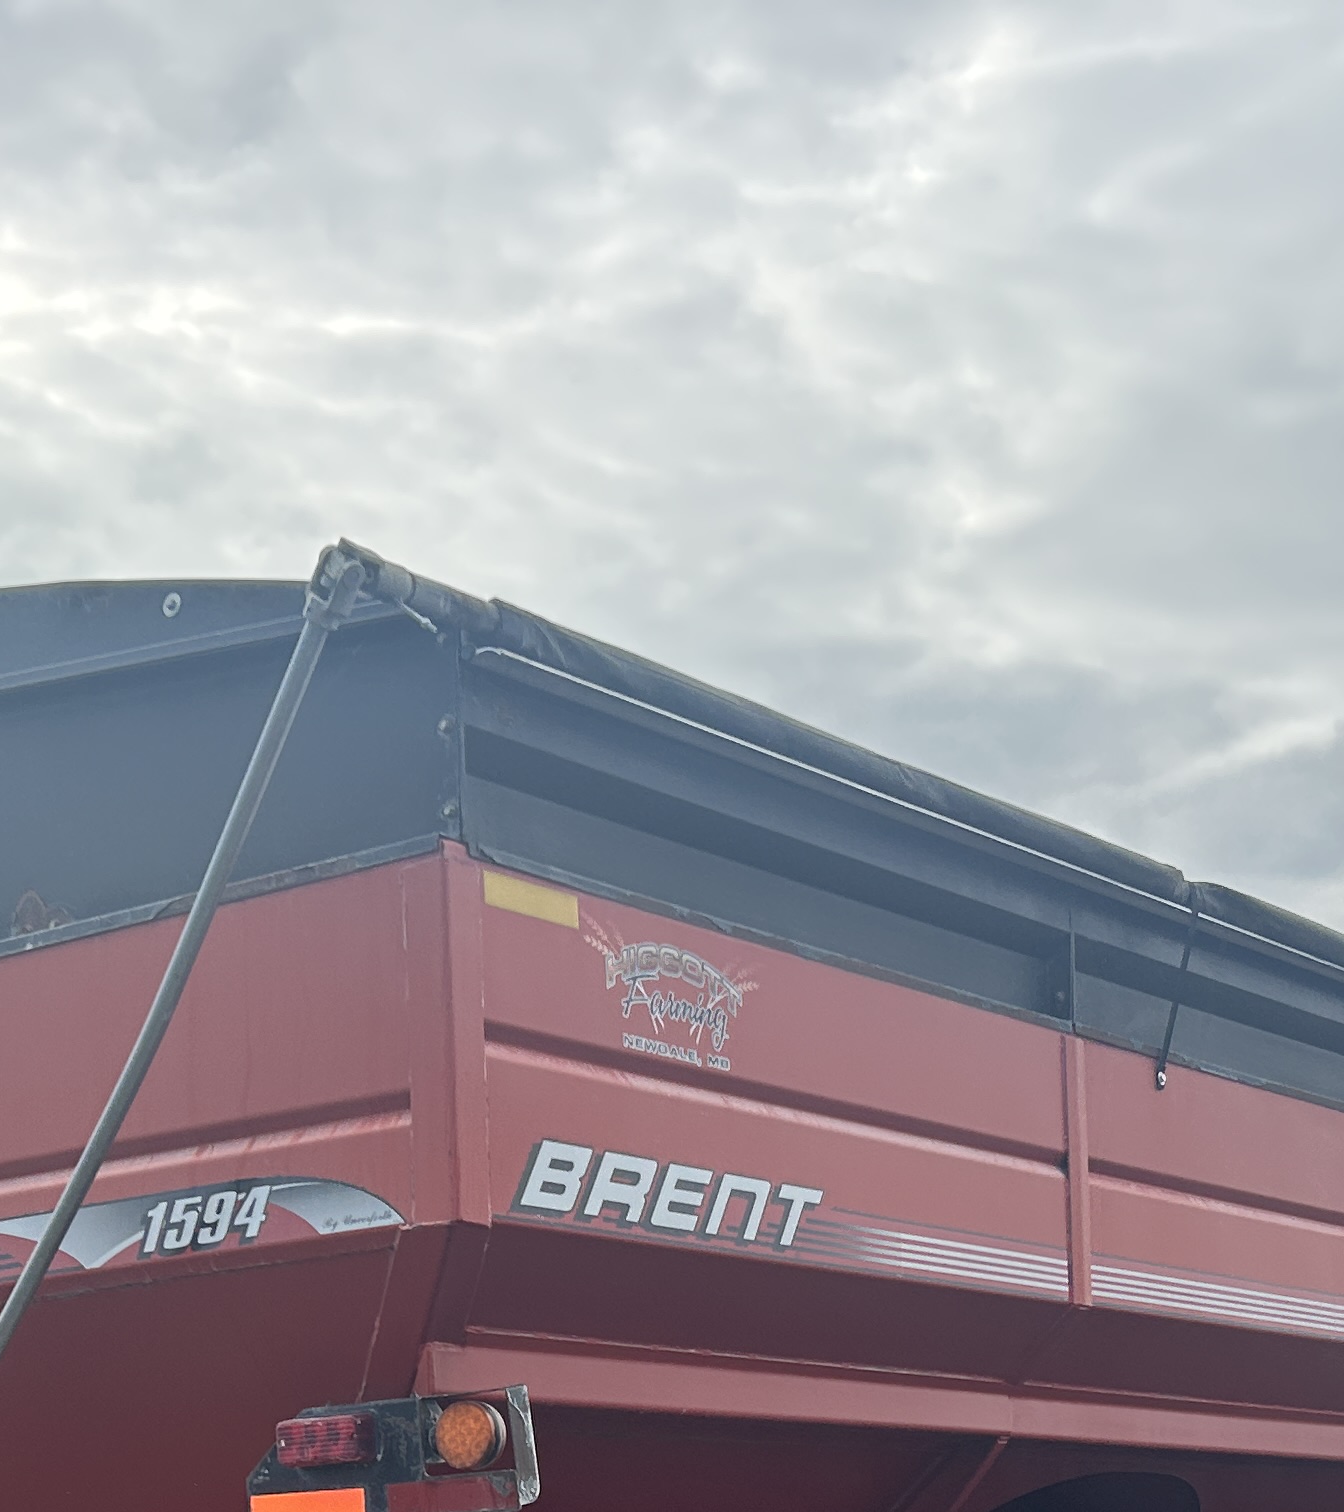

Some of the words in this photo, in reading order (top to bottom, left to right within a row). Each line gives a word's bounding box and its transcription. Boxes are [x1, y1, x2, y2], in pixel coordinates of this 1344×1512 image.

[606, 942, 743, 1018] HIGGOTT
[621, 974, 729, 1052] Farming
[142, 1184, 273, 1254] 1594
[519, 1138, 825, 1247] BRENT
